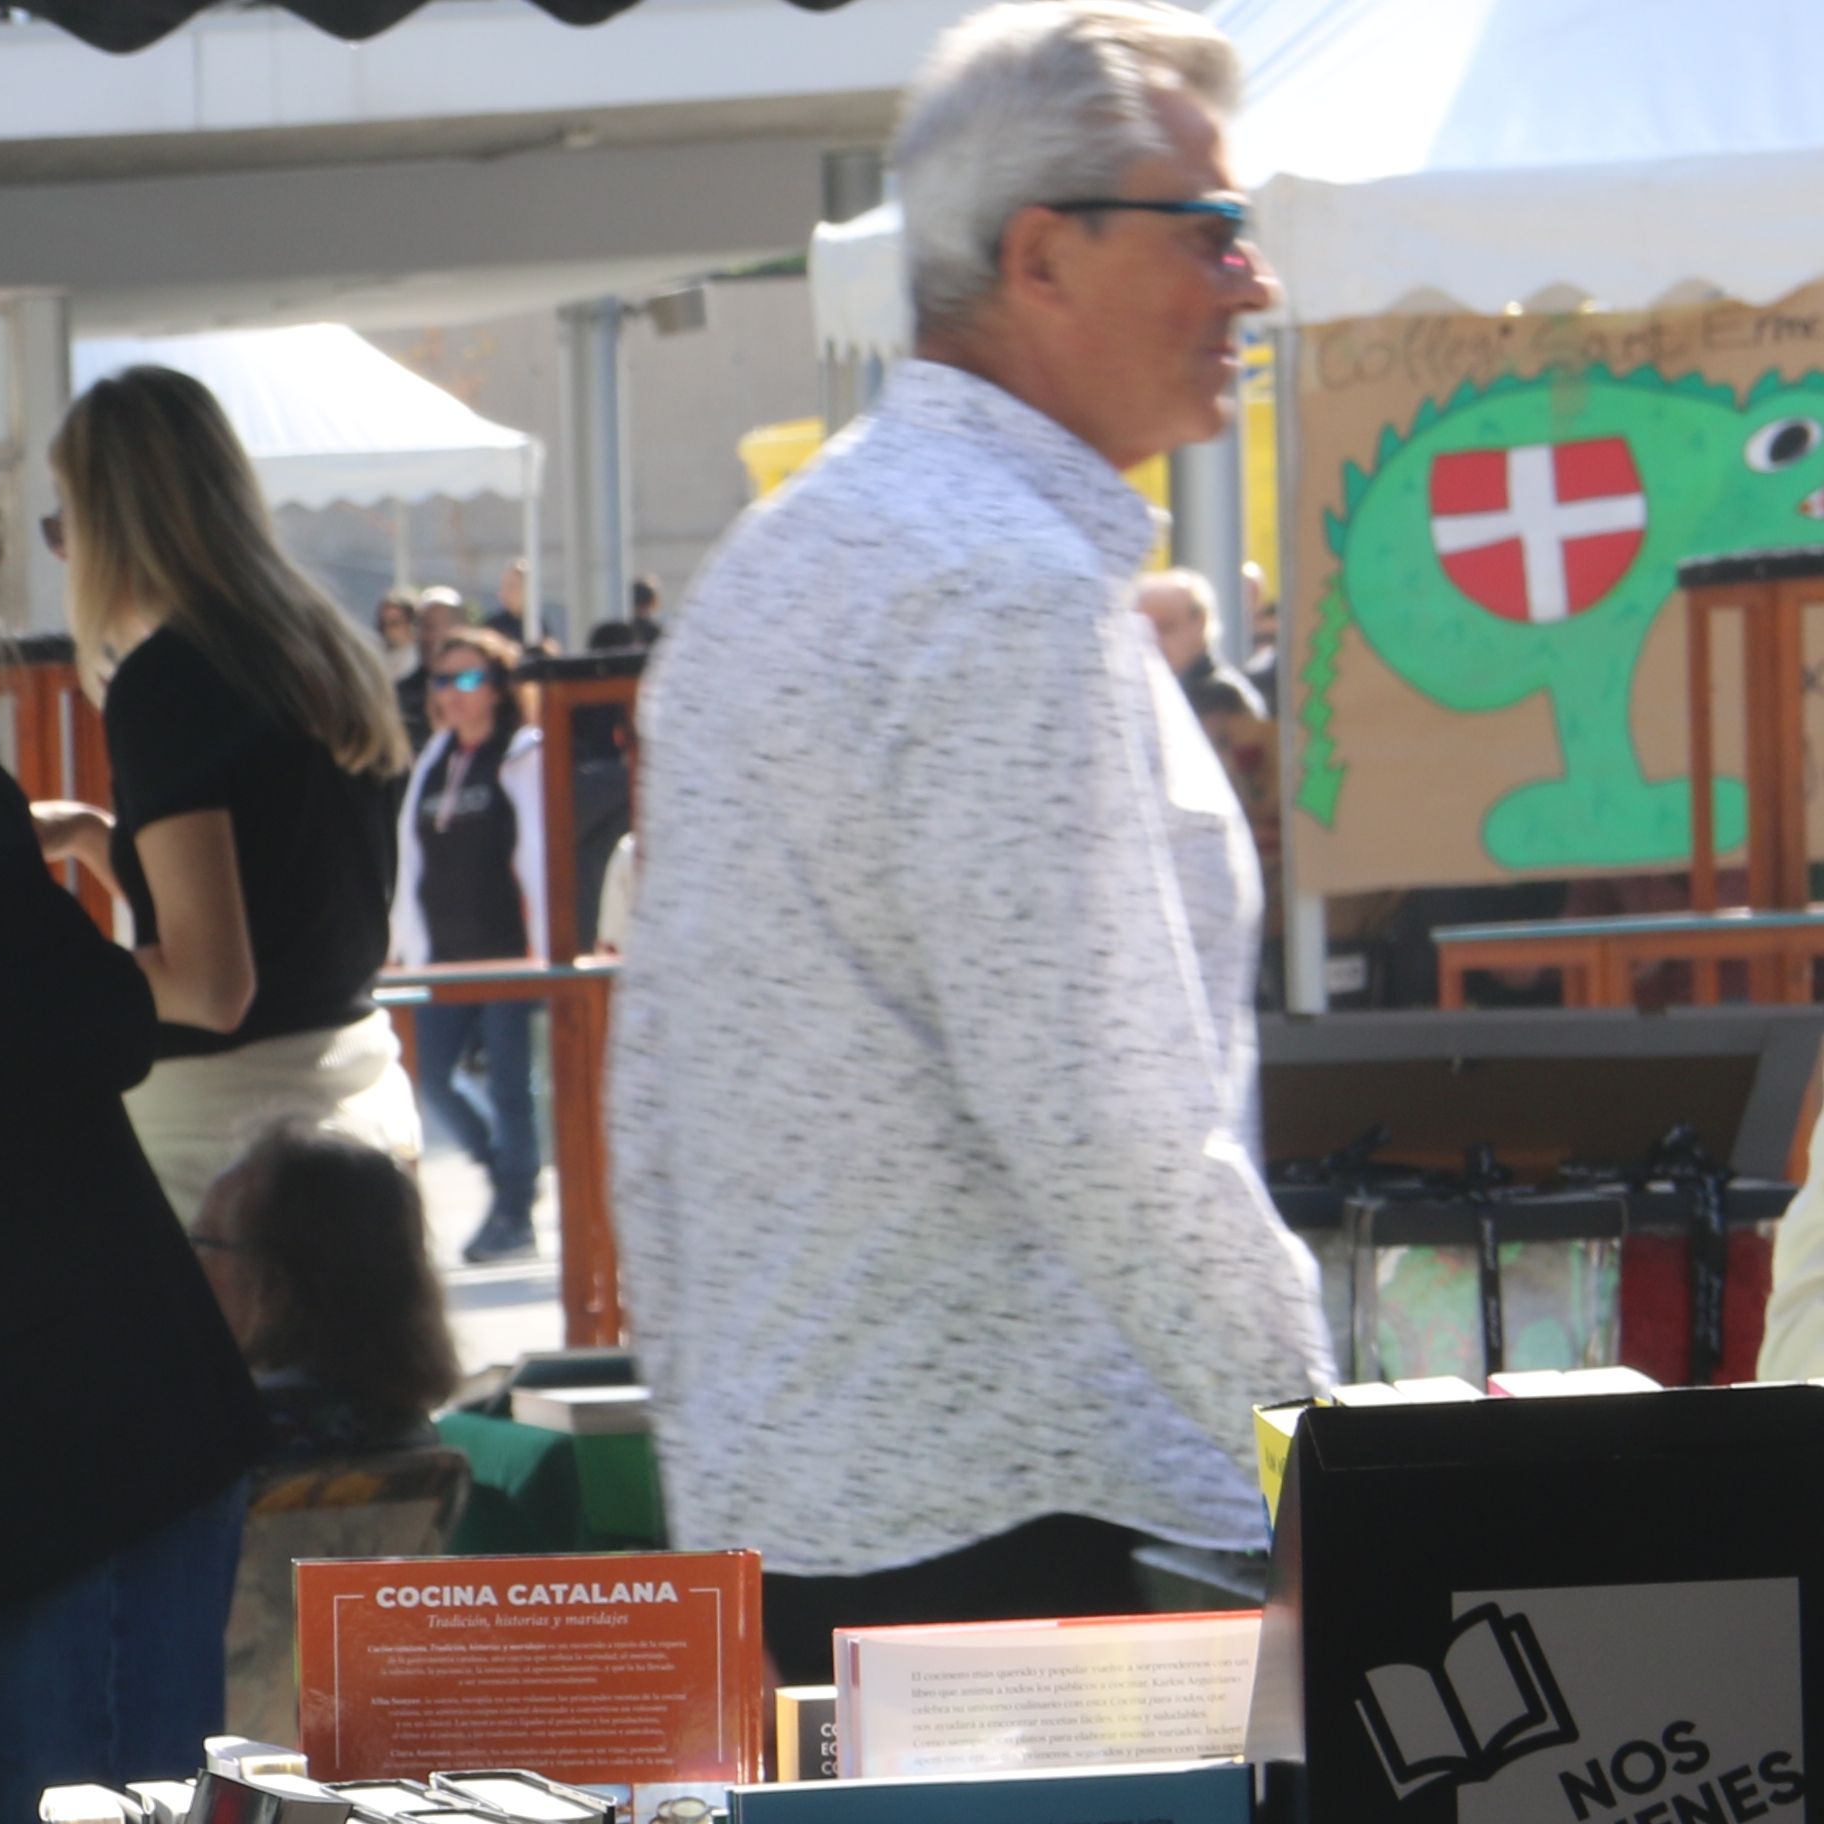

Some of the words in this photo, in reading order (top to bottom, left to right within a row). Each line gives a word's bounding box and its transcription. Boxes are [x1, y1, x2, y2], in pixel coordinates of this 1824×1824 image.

[375, 1585, 498, 1609] COCINA
[506, 1581, 679, 1605] CATALANA
[426, 1612, 492, 1630] Tradición,
[494, 1611, 550, 1628] historias
[552, 1615, 561, 1630] y
[564, 1610, 630, 1629] maridajes
[1559, 1719, 1712, 1822] NOS
